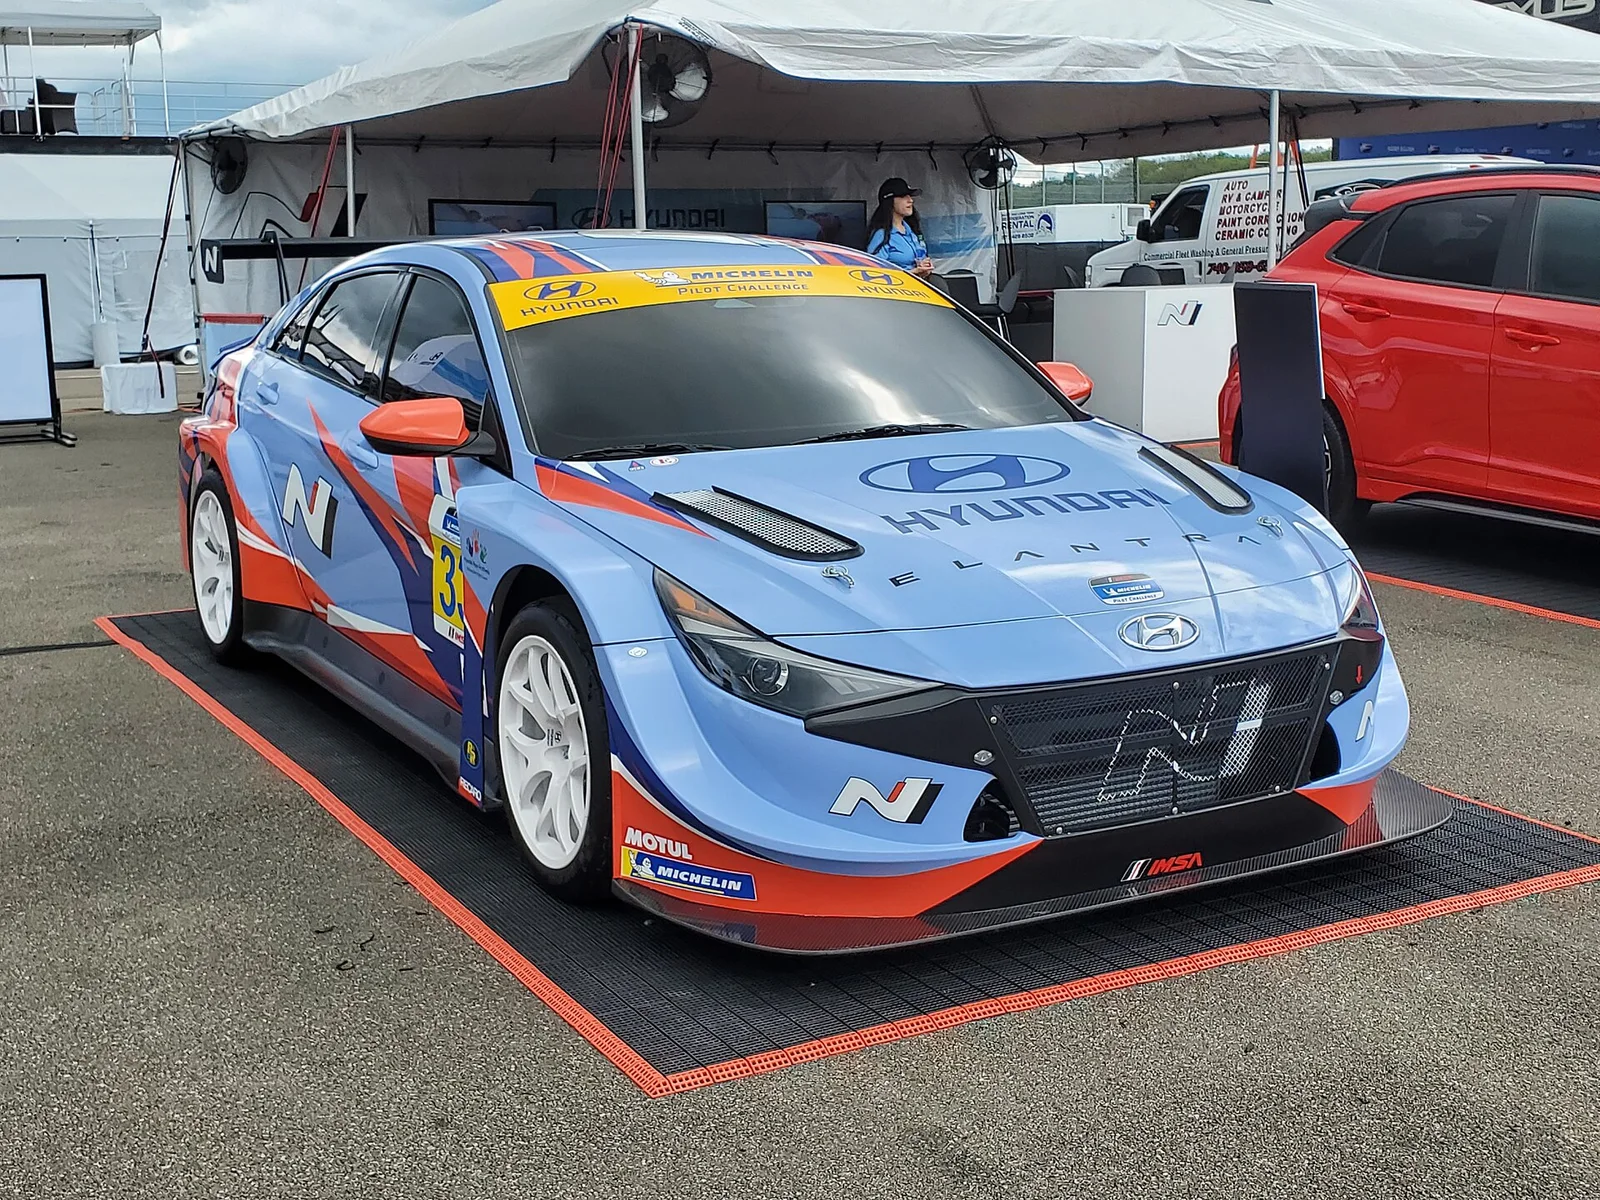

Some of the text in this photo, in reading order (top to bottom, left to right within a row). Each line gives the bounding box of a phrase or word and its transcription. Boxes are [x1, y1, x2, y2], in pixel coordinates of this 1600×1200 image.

[1224, 180, 1248, 191] AUTO
[1221, 193, 1233, 203] RV
[1245, 189, 1282, 202] CAMPR
[619, 208, 725, 228] HUNDAI
[1216, 212, 1305, 228] PAINT CORRCION
[1215, 225, 1298, 240] CERAMIC COTNG
[204, 246, 218, 274] N
[1175, 250, 1190, 259] Fleet
[1191, 247, 1214, 258] Washing
[1221, 246, 1244, 256] General
[1245, 245, 1268, 255] Pressur
[691, 270, 814, 280] MICHELIN
[677, 283, 809, 296] PILOT CHALLENGE
[858, 285, 931, 299] HYUNDAI
[521, 297, 619, 317] HYUNDAI
[1157, 300, 1202, 326] N
[282, 462, 339, 560] N
[881, 488, 1172, 535] HYUNDAI
[889, 534, 1262, 588] ELANTRA
[440, 544, 464, 623] 3
[1117, 584, 1151, 592] MICHELIN
[828, 776, 944, 824] N
[625, 827, 693, 860] MOTUL
[1147, 853, 1202, 876] IMSA
[657, 866, 742, 891] MICHELIN
